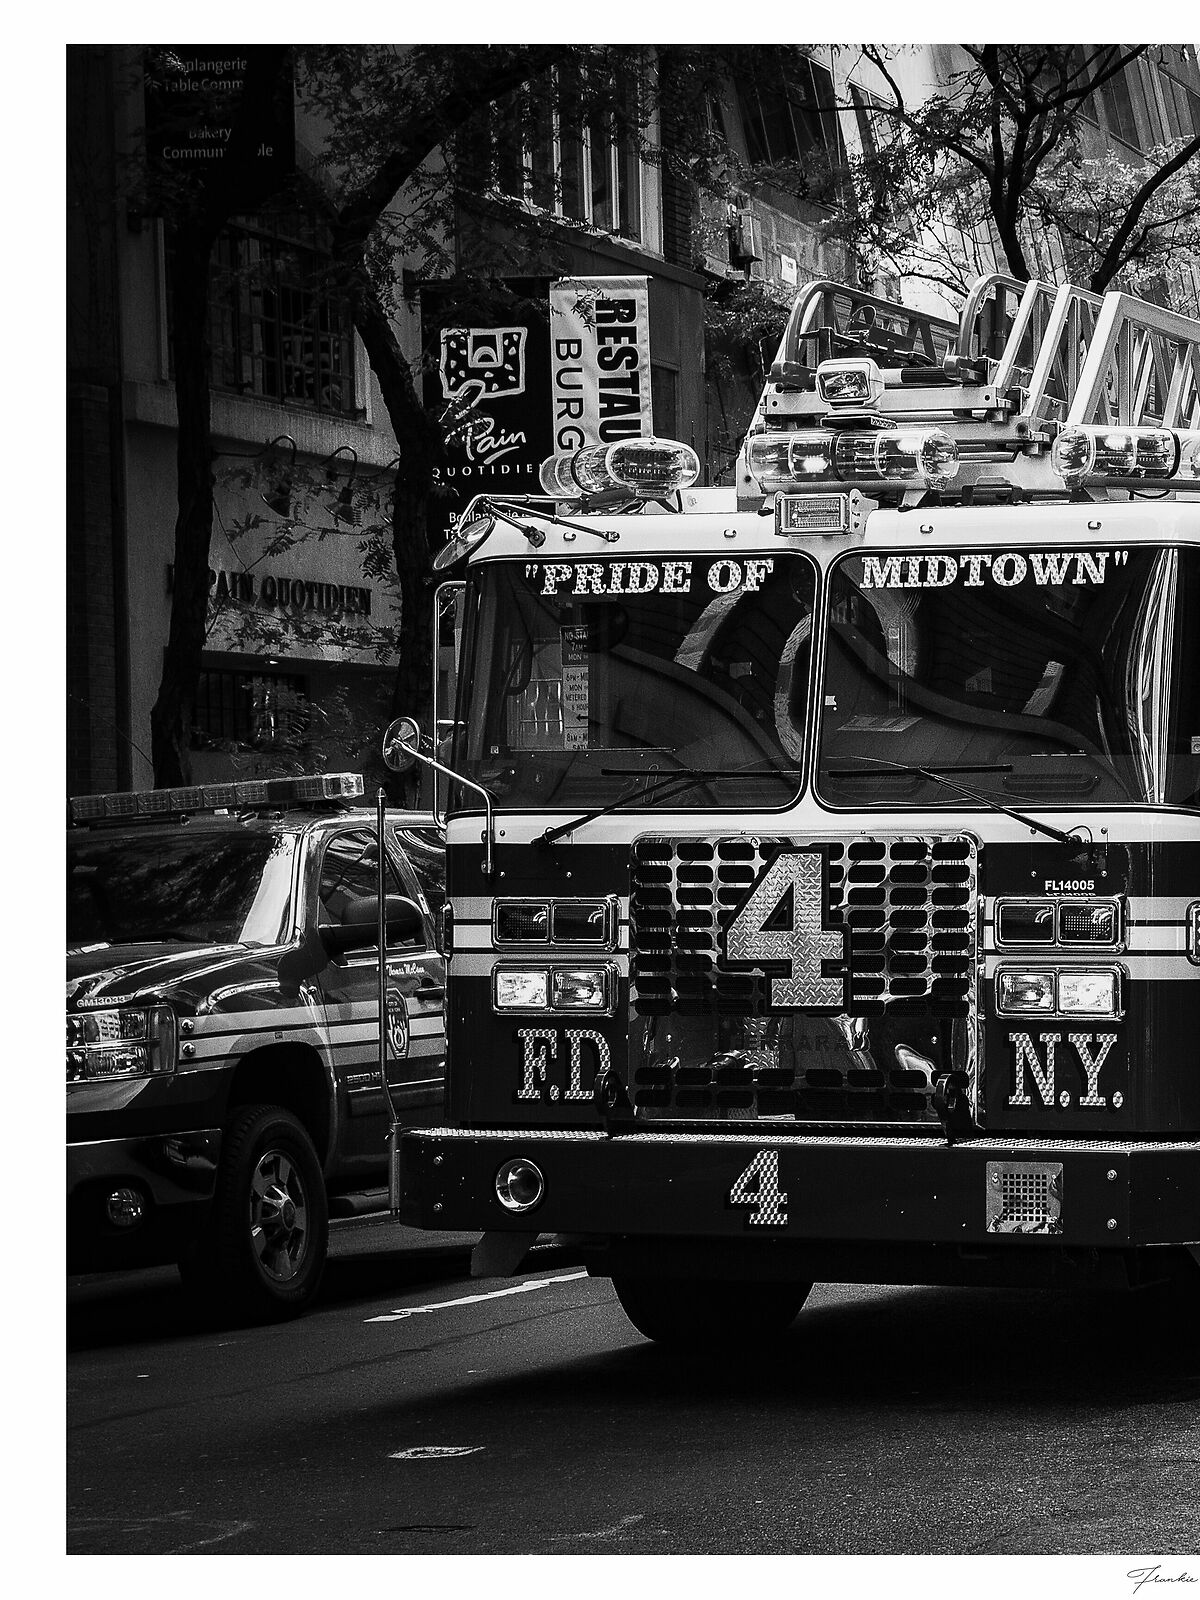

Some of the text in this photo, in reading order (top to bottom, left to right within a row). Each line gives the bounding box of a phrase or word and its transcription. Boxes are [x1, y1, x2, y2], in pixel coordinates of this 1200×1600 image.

[162, 146, 228, 160] Commun
[594, 299, 643, 443] RESTAU
[555, 338, 586, 452] BURG
[432, 463, 541, 479] QUOTIDIE
[525, 559, 774, 595] "PRIDE OF
[860, 551, 1129, 589] MIDTOWN"
[261, 575, 373, 616] QUOTIDIEN
[1045, 880, 1095, 891] FL14005
[725, 852, 844, 1007] 4
[1008, 1032, 1125, 1109] N.Y.
[730, 1149, 789, 1226] 4
